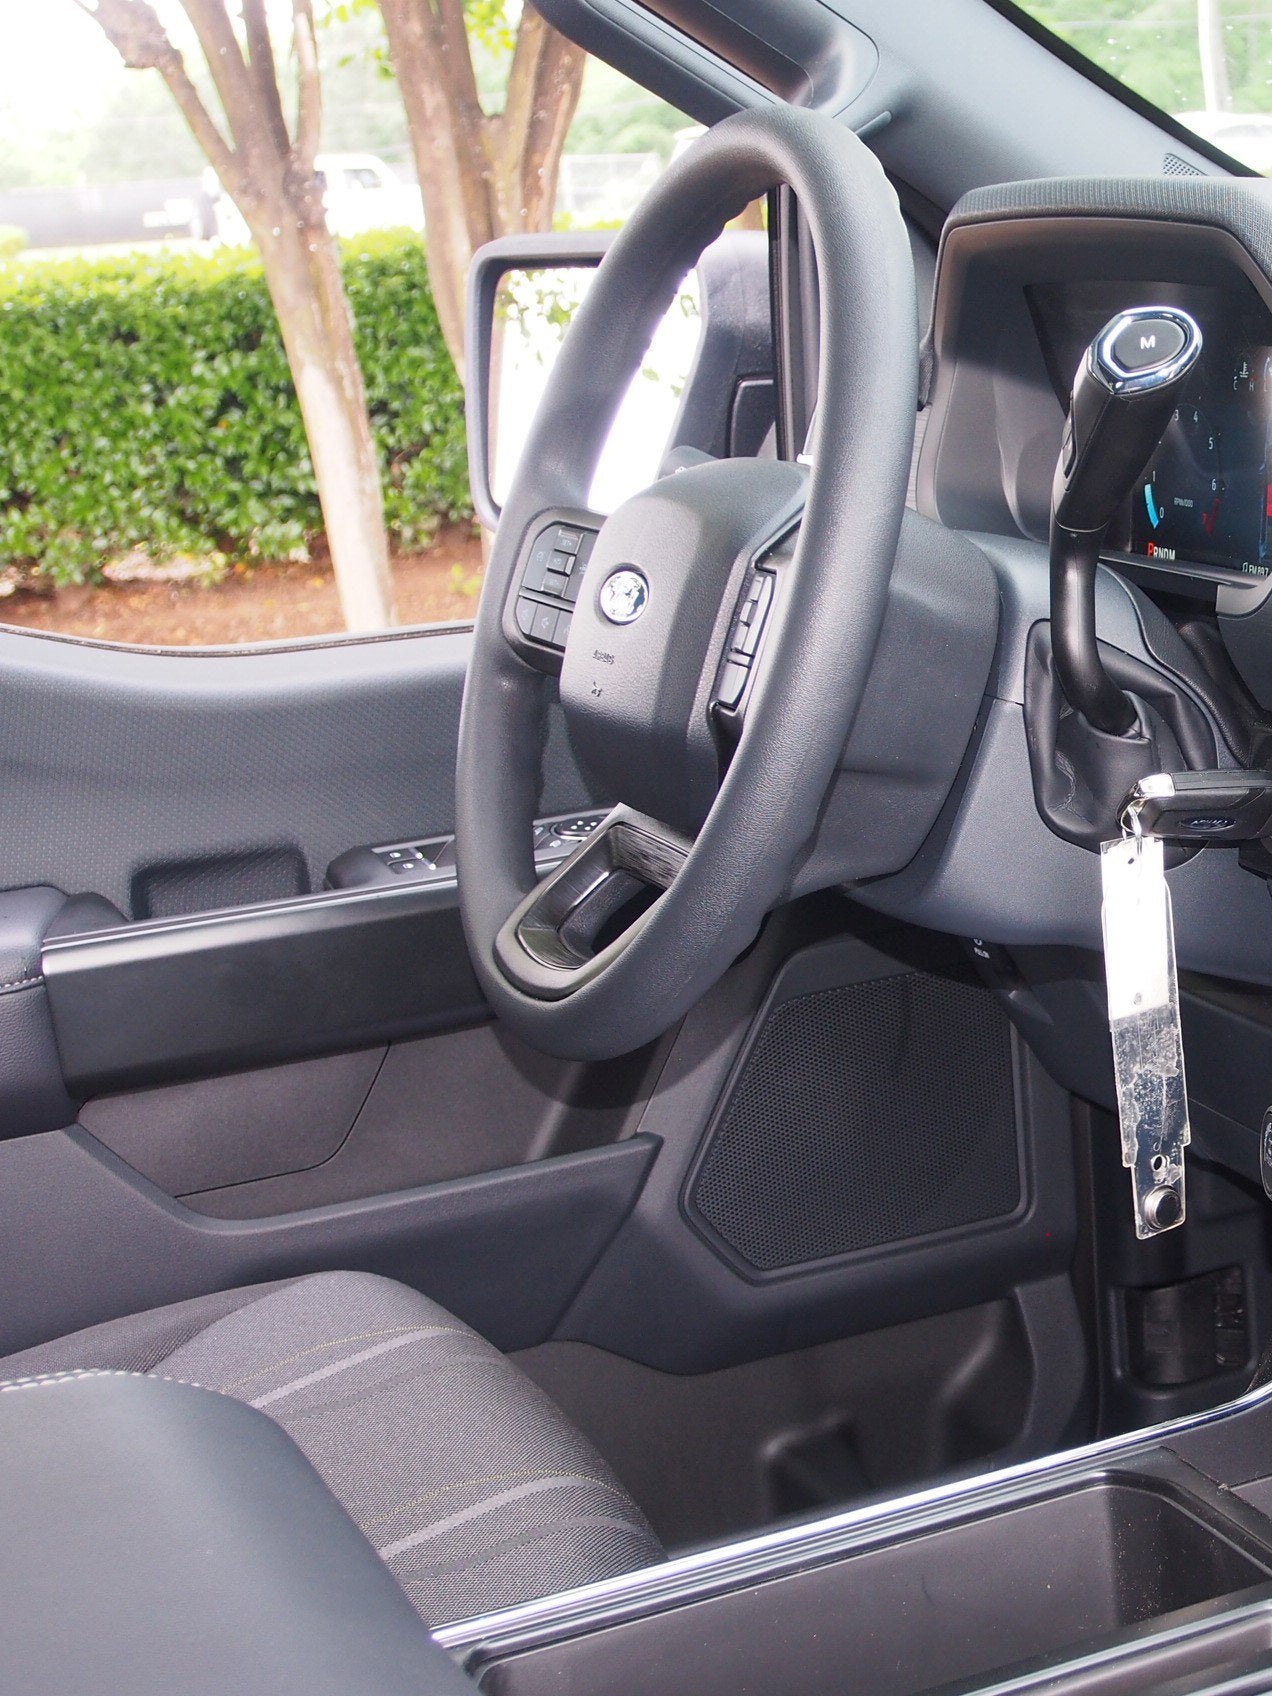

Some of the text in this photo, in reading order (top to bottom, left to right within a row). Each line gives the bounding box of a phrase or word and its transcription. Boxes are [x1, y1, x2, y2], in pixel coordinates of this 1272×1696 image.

[1140, 335, 1156, 350] M
[1174, 409, 1180, 421] 3
[1193, 411, 1199, 423] 4
[1208, 437, 1214, 450] 5
[1211, 478, 1217, 491] 6
